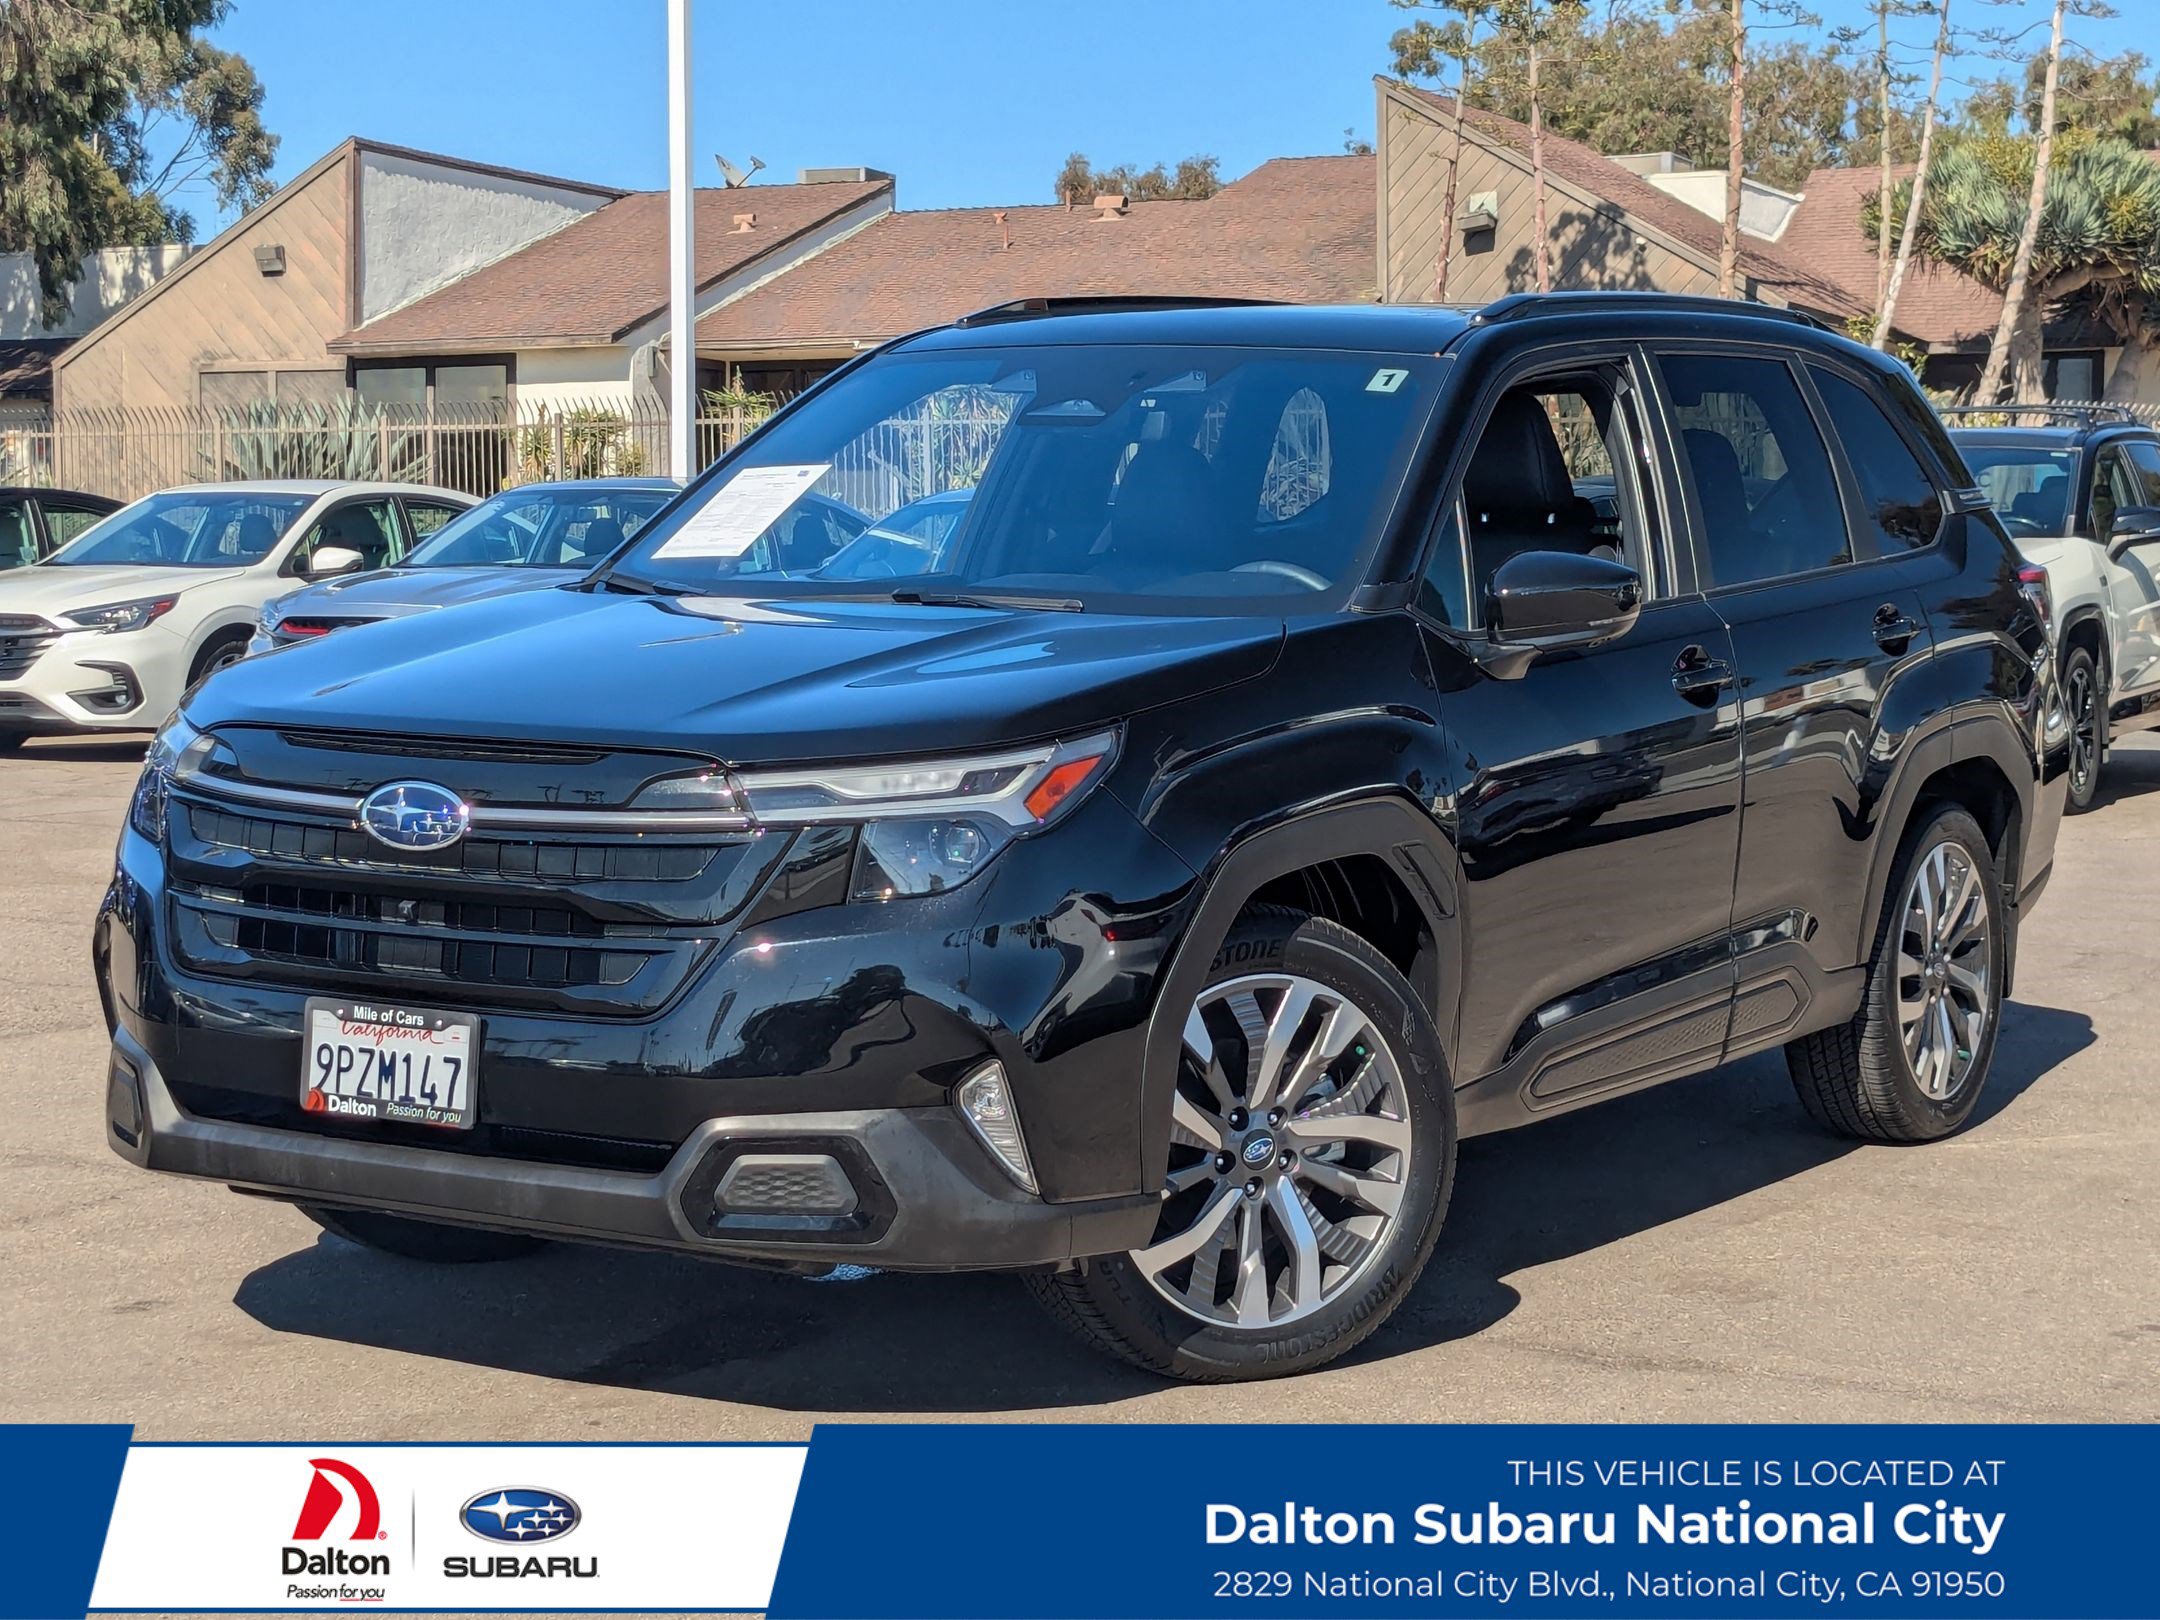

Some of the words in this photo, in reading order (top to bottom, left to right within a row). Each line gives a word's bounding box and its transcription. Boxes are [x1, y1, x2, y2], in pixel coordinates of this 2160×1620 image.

[1382, 373, 1397, 387] 1
[353, 1005, 378, 1021] Mile
[380, 1009, 394, 1022] of
[396, 1011, 424, 1026] Cars
[316, 1043, 462, 1108] 9PZM147
[328, 1095, 377, 1117] Dalton
[386, 1102, 423, 1119] Passion
[425, 1108, 440, 1119] for
[442, 1111, 462, 1124] you
